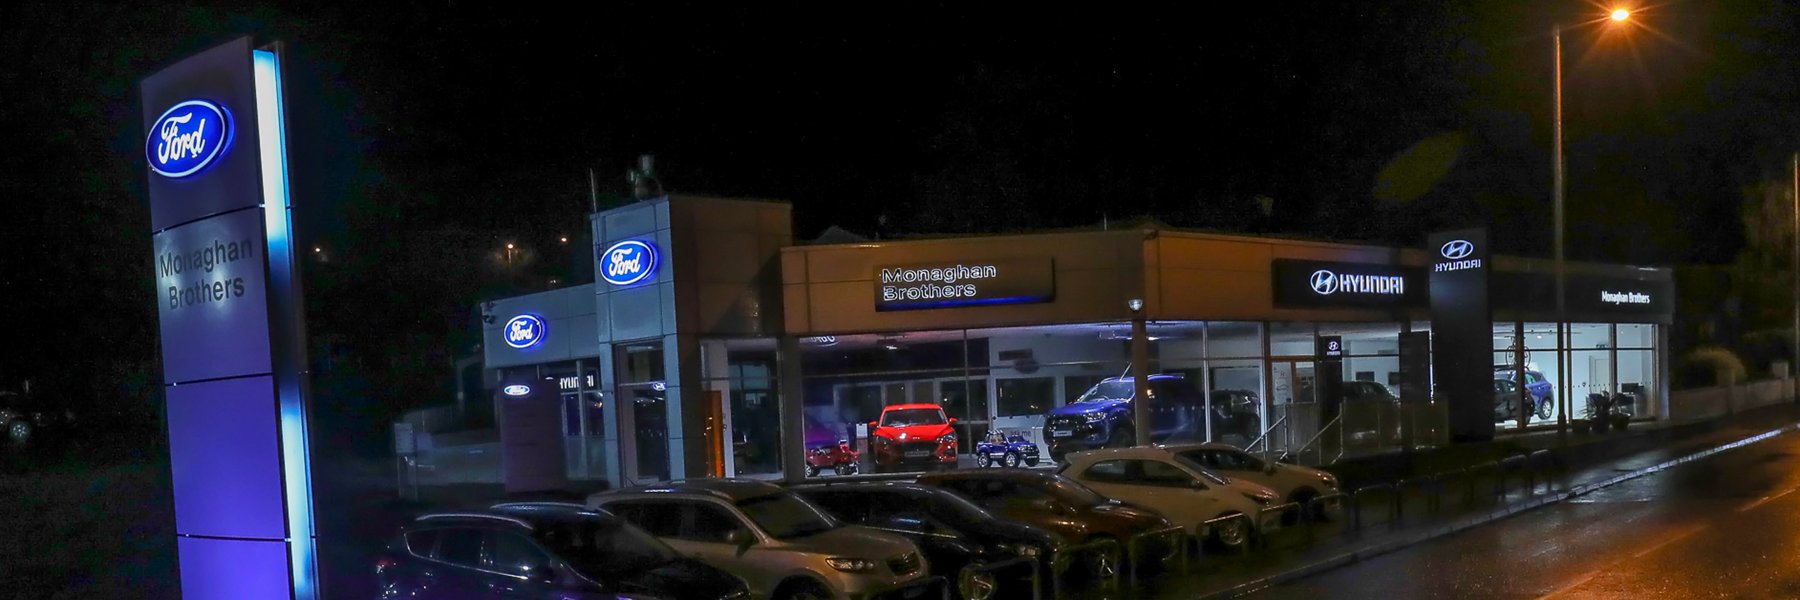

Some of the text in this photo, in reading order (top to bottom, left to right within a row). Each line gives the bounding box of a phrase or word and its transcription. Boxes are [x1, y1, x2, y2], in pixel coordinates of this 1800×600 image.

[158, 112, 206, 164] Ford
[160, 239, 253, 278] Monaghan
[608, 247, 641, 276] Ford
[1435, 259, 1481, 272] HYUNDAI
[882, 264, 997, 284] Monaghan
[1340, 274, 1404, 295] HYUNDAI
[169, 277, 245, 309] Brothers
[883, 283, 977, 301] Brothers
[1601, 290, 1650, 305] Monaghan Brothers
[510, 320, 533, 341] Ford
